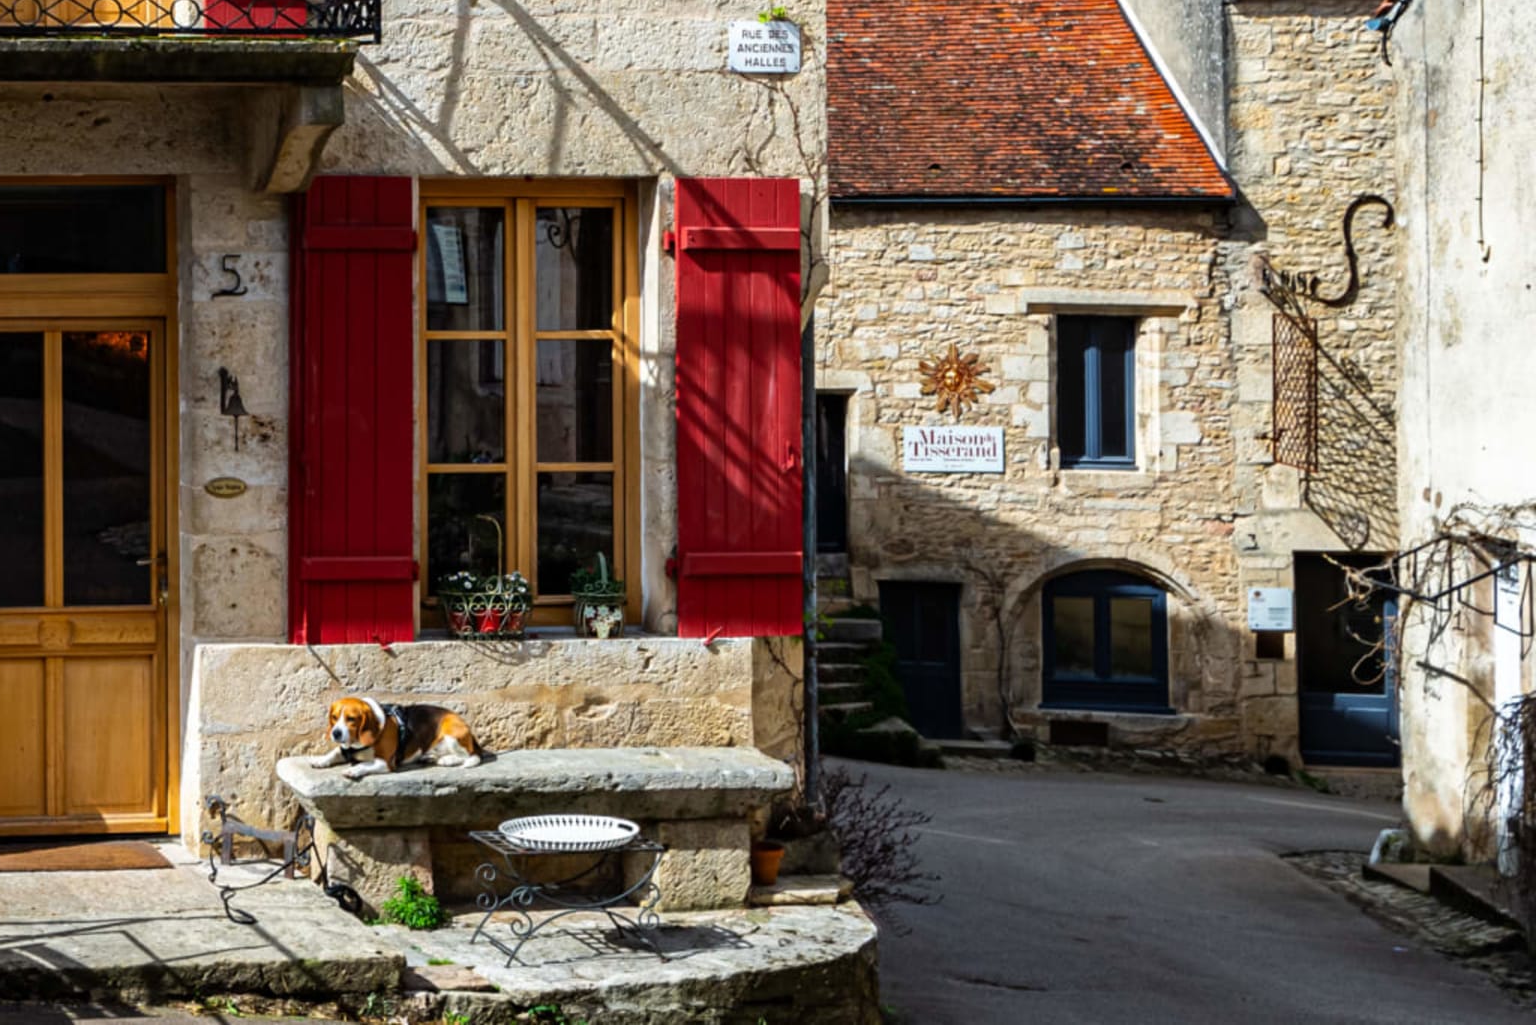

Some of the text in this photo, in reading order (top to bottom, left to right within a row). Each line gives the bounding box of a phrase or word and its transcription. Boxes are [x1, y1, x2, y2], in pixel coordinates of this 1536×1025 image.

[742, 29, 788, 39] RUE DES
[737, 43, 794, 53] ANCIENNES
[745, 57, 786, 67] HALLES
[216, 254, 244, 296] 5
[920, 429, 984, 445] Maison
[908, 441, 996, 457] Tisserand
